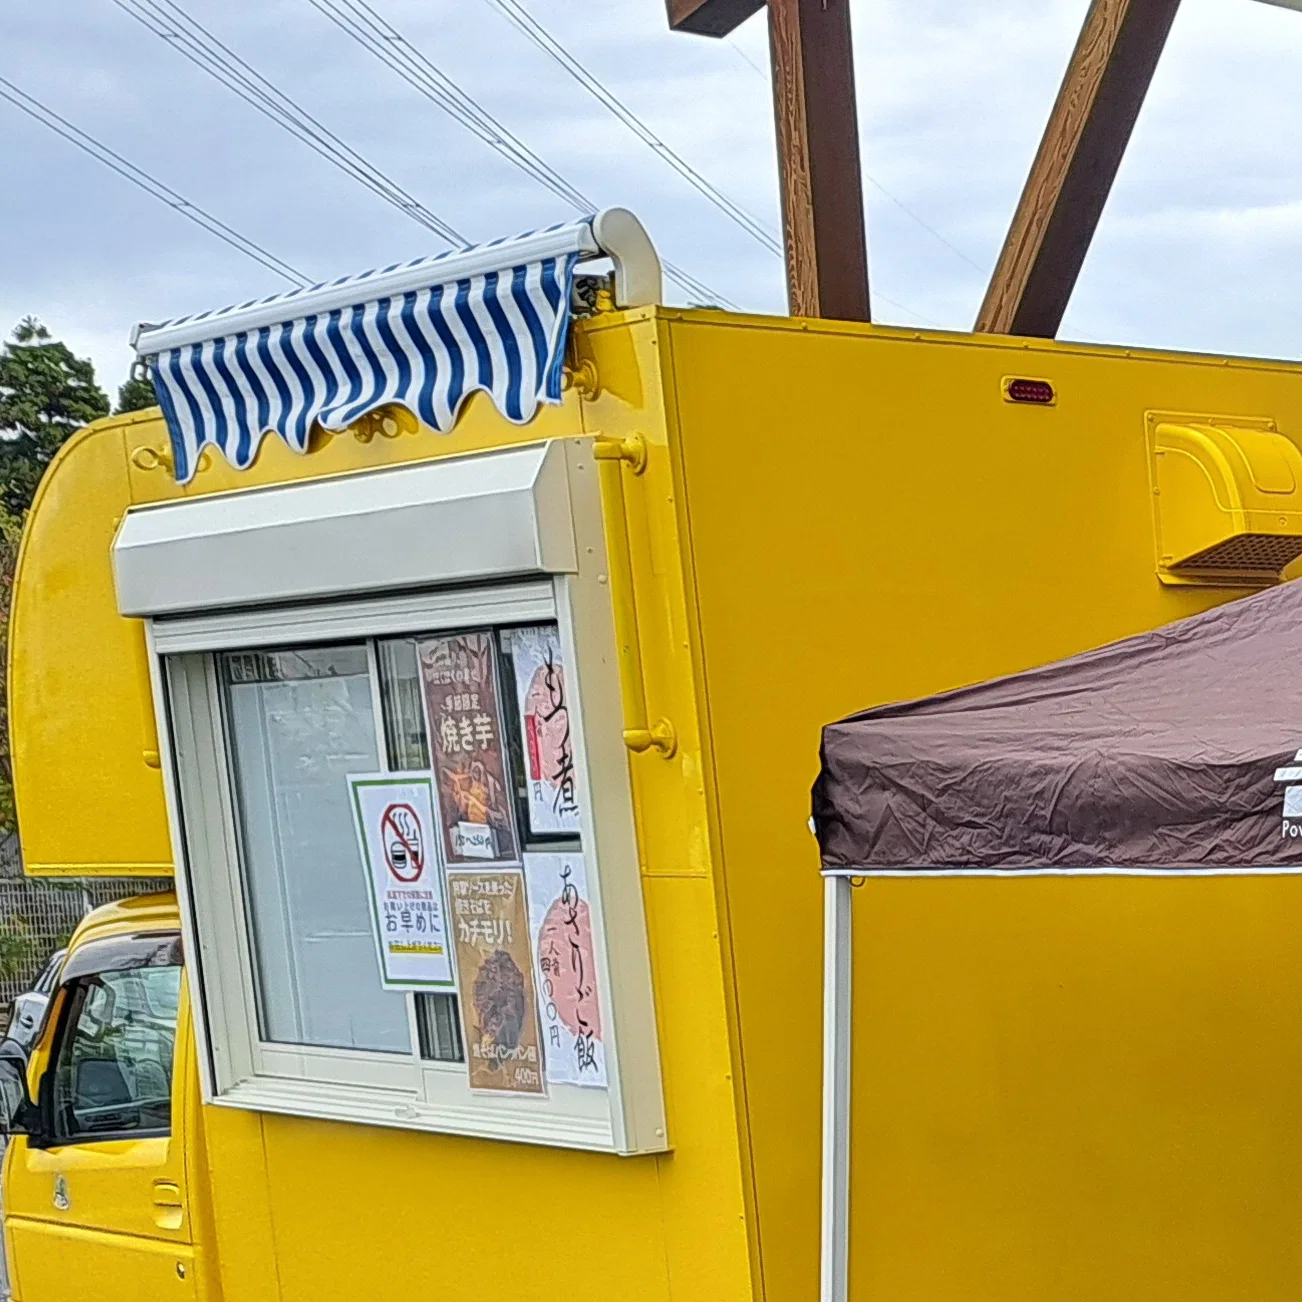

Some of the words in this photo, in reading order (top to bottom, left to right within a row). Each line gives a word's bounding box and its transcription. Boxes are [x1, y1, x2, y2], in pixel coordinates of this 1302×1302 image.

[440, 712, 495, 753] 焼き芋
[385, 911, 441, 933] お早めに
[459, 919, 514, 947] カチモリ!
[560, 864, 599, 1073] あさりご飯
